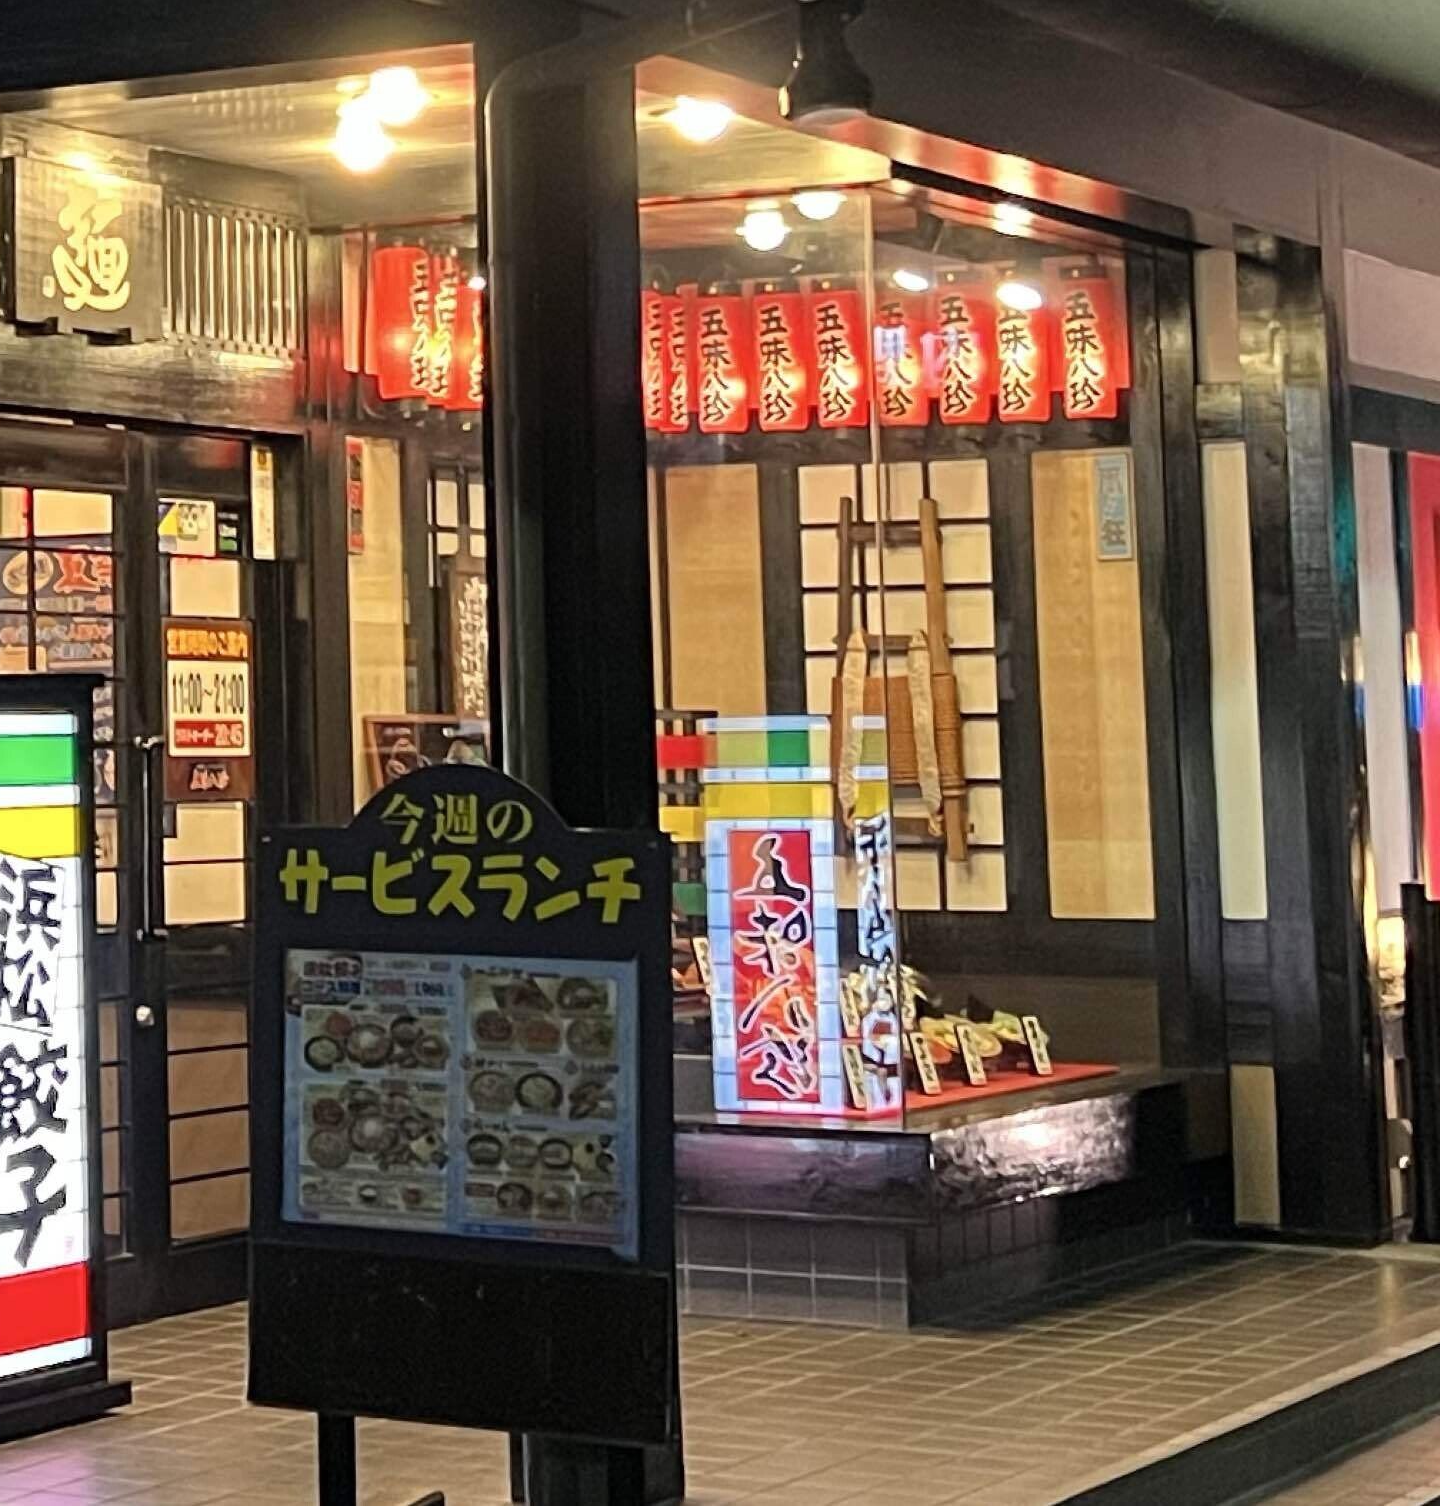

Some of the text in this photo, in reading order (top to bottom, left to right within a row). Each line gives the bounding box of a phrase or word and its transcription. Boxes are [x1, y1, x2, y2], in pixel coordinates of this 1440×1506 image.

[701, 308, 732, 422] 五味八珍
[758, 305, 793, 423] 五味八珍
[816, 304, 852, 419] 五味八珍
[879, 301, 913, 418] 五八珍
[1066, 292, 1101, 411] 五味八珍
[380, 793, 533, 845] 今週の
[279, 848, 642, 924] サービスランチ
